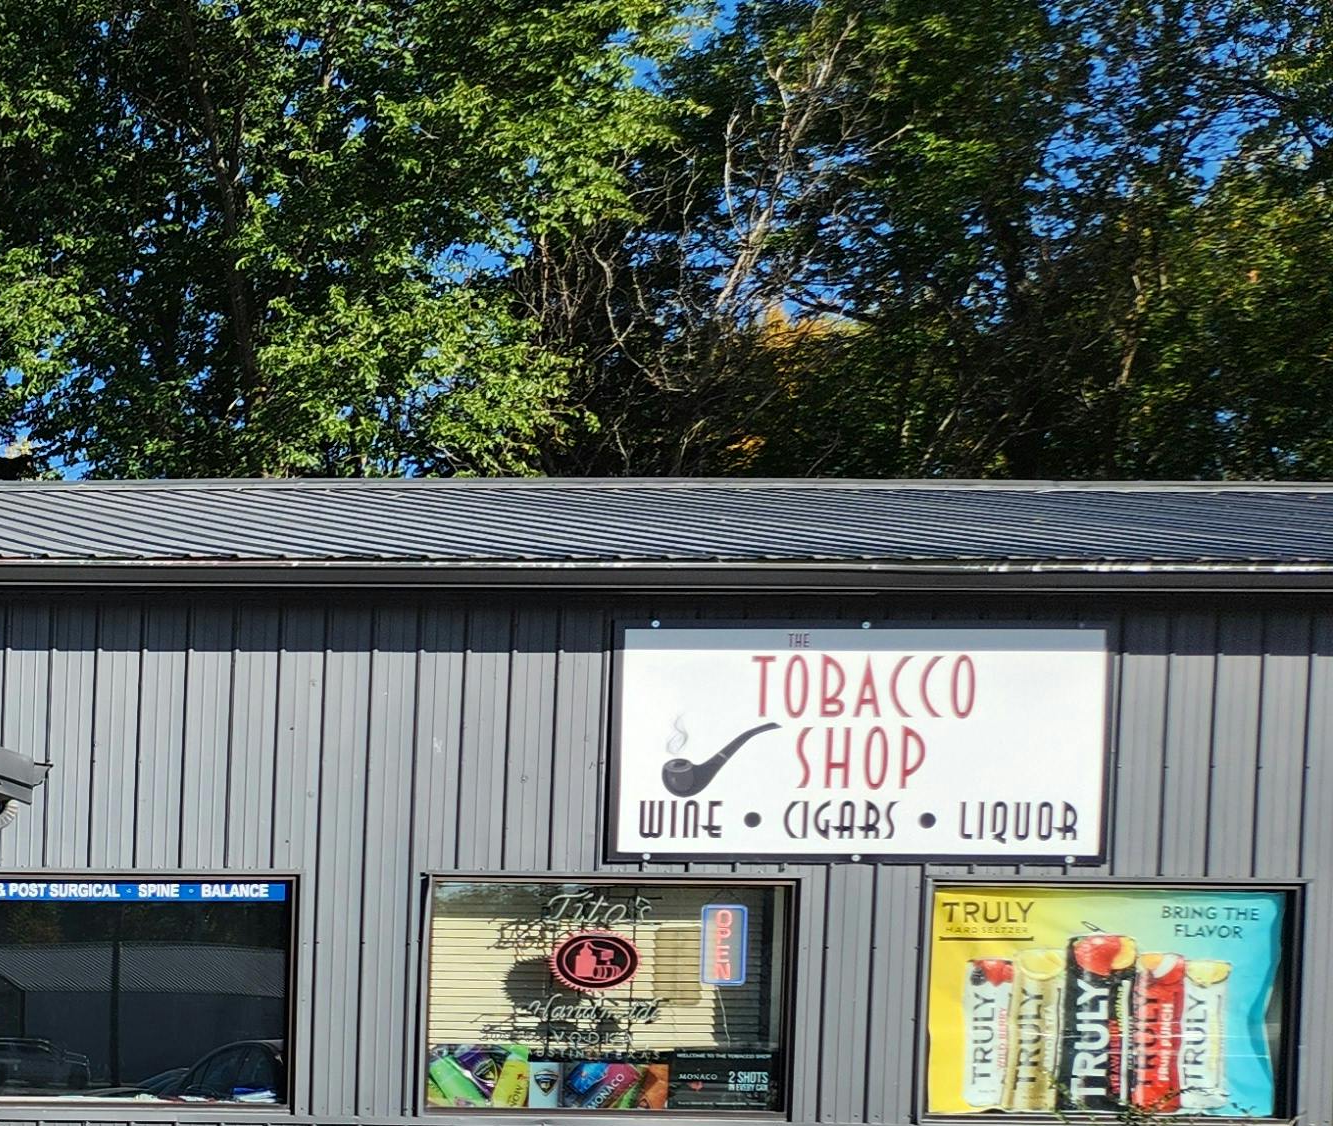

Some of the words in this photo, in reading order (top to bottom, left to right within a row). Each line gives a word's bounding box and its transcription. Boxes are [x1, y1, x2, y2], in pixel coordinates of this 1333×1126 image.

[788, 632, 810, 648] THE
[751, 653, 976, 719] TOBACCO
[796, 725, 926, 790] SHOP
[639, 799, 724, 839] WINE
[783, 799, 901, 840] CIGARS
[959, 800, 1078, 844] LIQUOR
[9, 884, 47, 897] POST
[49, 884, 121, 898] SURGICAL
[138, 884, 180, 897] SPINE
[201, 884, 270, 898] BALANCE
[942, 901, 1035, 923] TRULY
[1161, 905, 1217, 920] BRING
[1223, 907, 1260, 921] THE
[714, 908, 733, 981] OPEN
[946, 926, 978, 934] HARD
[981, 926, 1028, 934] SELTZER
[1174, 923, 1243, 939] FLAVOR
[971, 992, 995, 1085] TRULY
[998, 1007, 1009, 1040] BERRY
[1013, 987, 1044, 1091] TRULY
[1071, 978, 1110, 1101] TRULY
[1159, 1003, 1174, 1047] PUNCH
[1183, 993, 1207, 1085] TRULY
[997, 1043, 1007, 1070] WILD
[1157, 1049, 1170, 1082] FRUIT
[677, 1073, 718, 1081] MONACO
[728, 1071, 735, 1083] 2
[737, 1071, 769, 1084] SHOTS
[736, 1083, 755, 1091] EVERY
